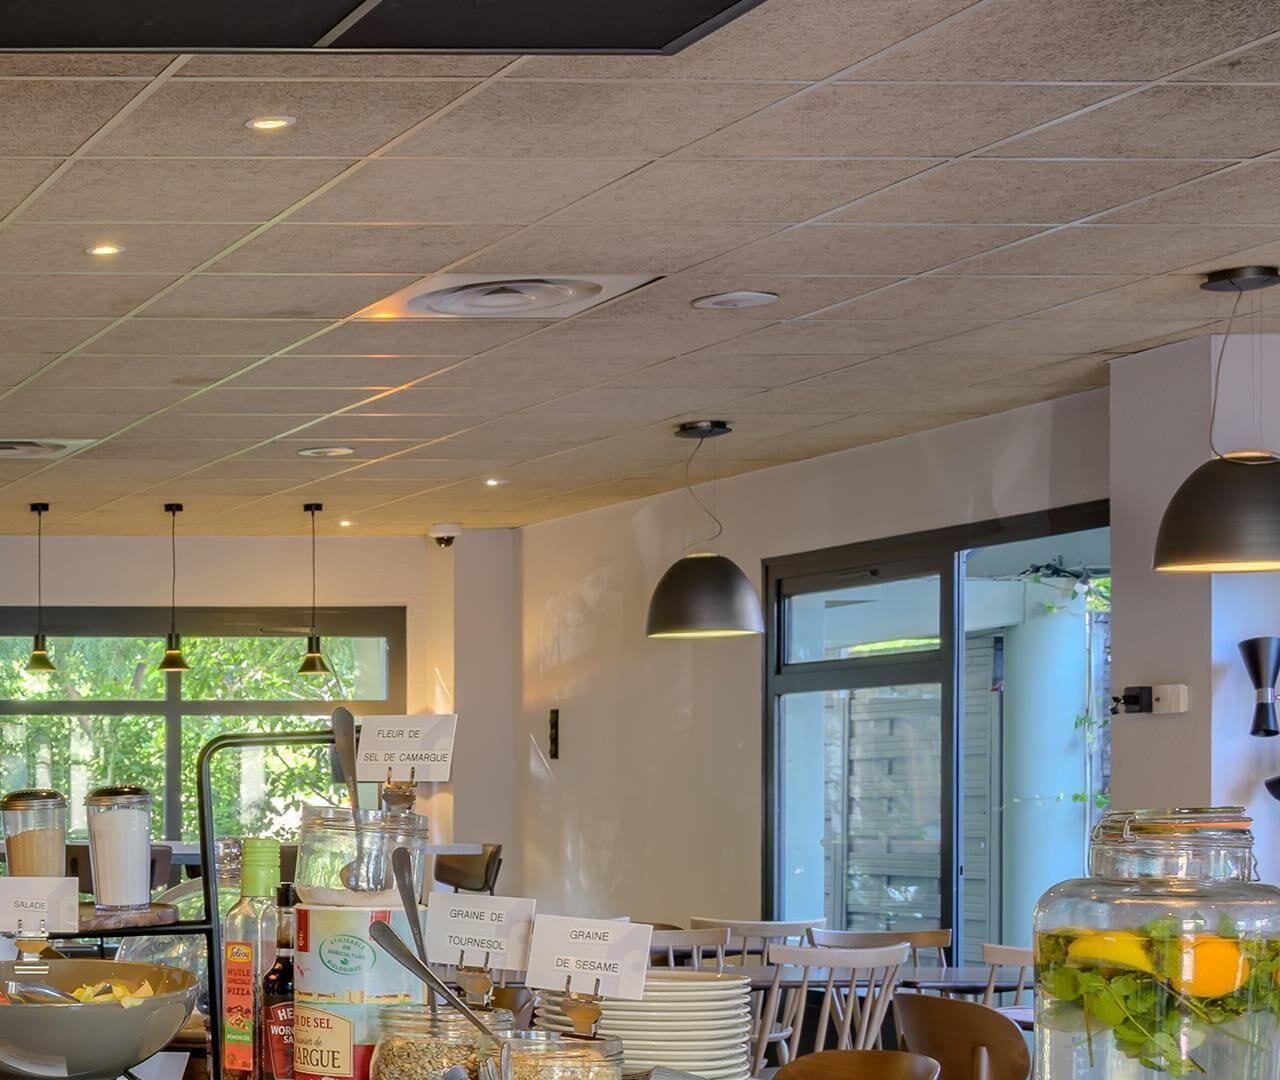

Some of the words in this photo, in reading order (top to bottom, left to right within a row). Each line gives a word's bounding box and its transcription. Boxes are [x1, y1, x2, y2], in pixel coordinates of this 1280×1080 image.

[377, 729, 404, 738] FLEUR
[408, 729, 421, 738] DE
[363, 753, 379, 762] SEL
[383, 753, 395, 762] DE
[399, 753, 449, 762] CAMARGUE
[14, 900, 46, 909] SALADE
[449, 909, 485, 921] GRAINE
[490, 912, 504, 922] DE
[569, 930, 609, 941] GRAINE
[448, 936, 504, 951] TOURNESOL
[555, 958, 570, 968] DE
[574, 959, 619, 973] SESAME
[227, 968, 251, 976] HUILE
[227, 987, 251, 996] PIZZA
[300, 1016, 312, 1028] DE
[313, 1018, 334, 1029] SEL
